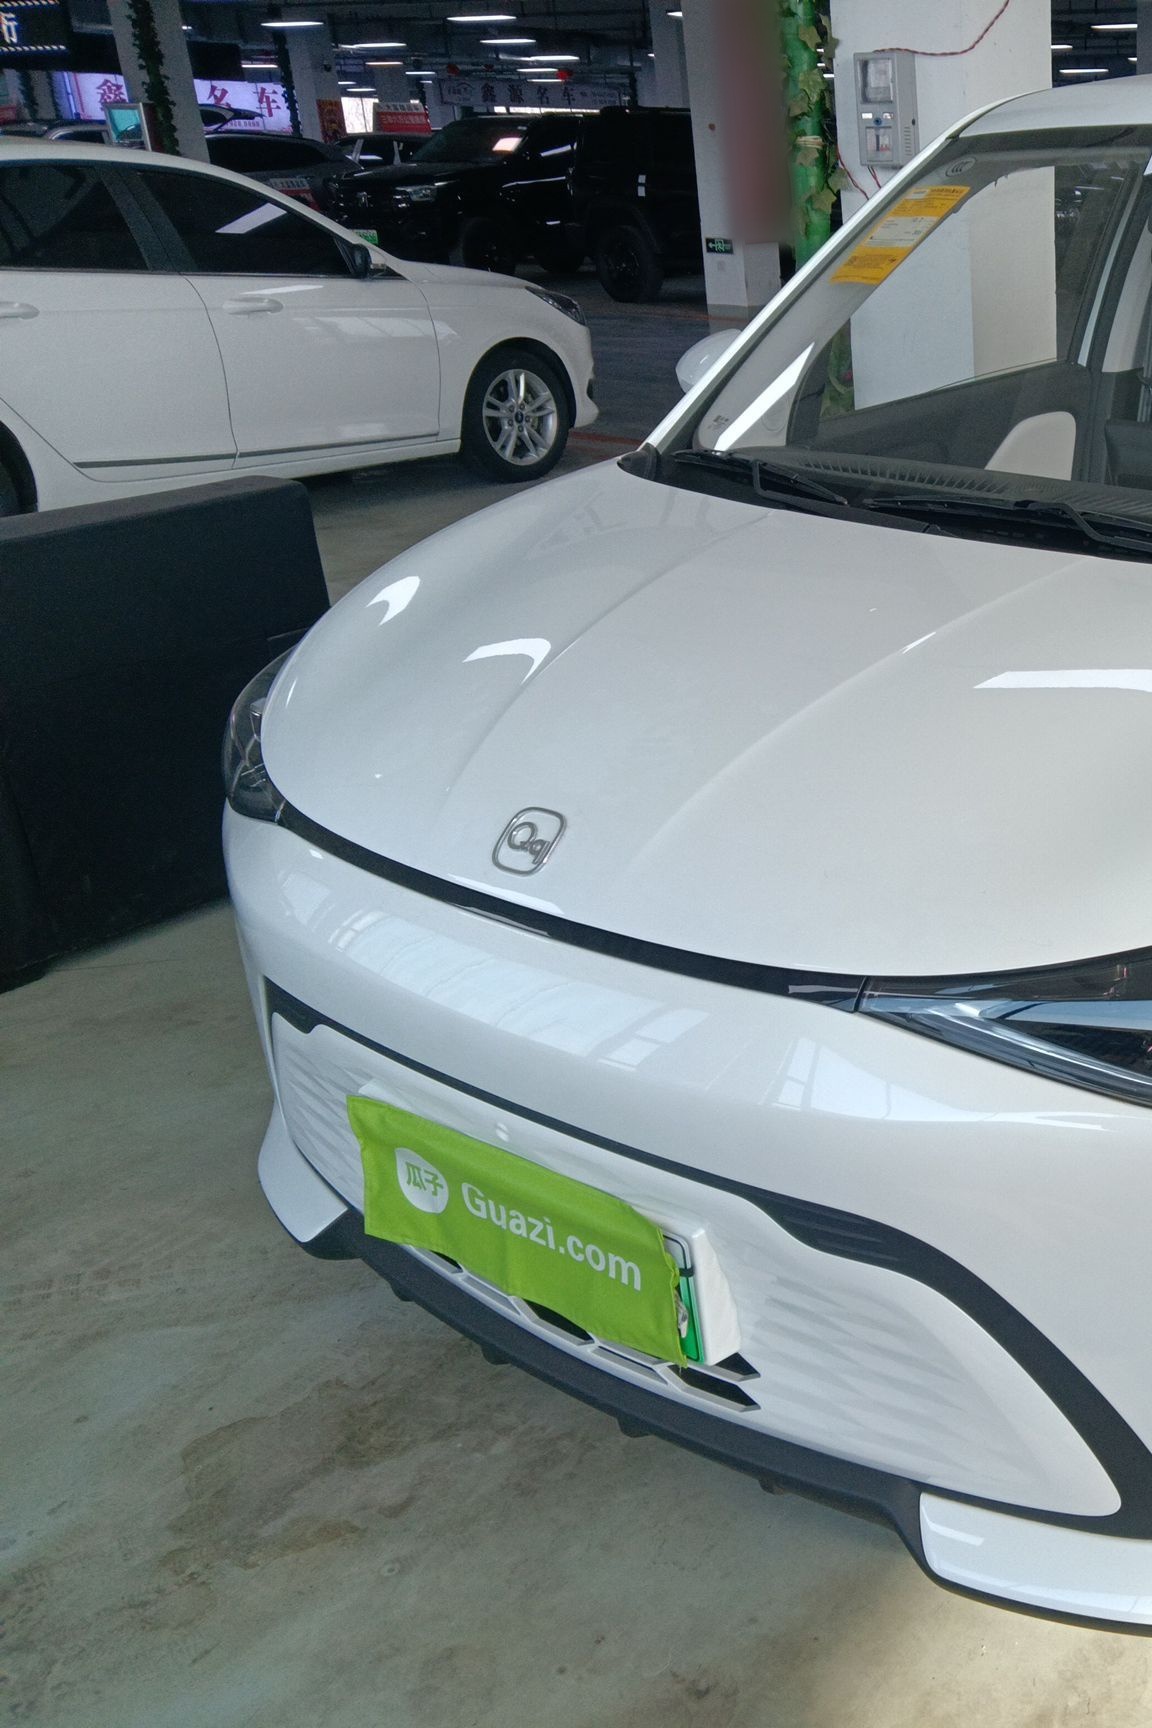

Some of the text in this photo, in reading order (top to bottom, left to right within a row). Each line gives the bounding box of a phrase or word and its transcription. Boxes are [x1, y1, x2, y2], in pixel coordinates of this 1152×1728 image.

[97, 79, 281, 118] 鑫名车
[481, 82, 574, 106] 鑫源名车
[404, 1161, 445, 1198] 瓜子
[461, 1181, 642, 1292] Guazi.com
